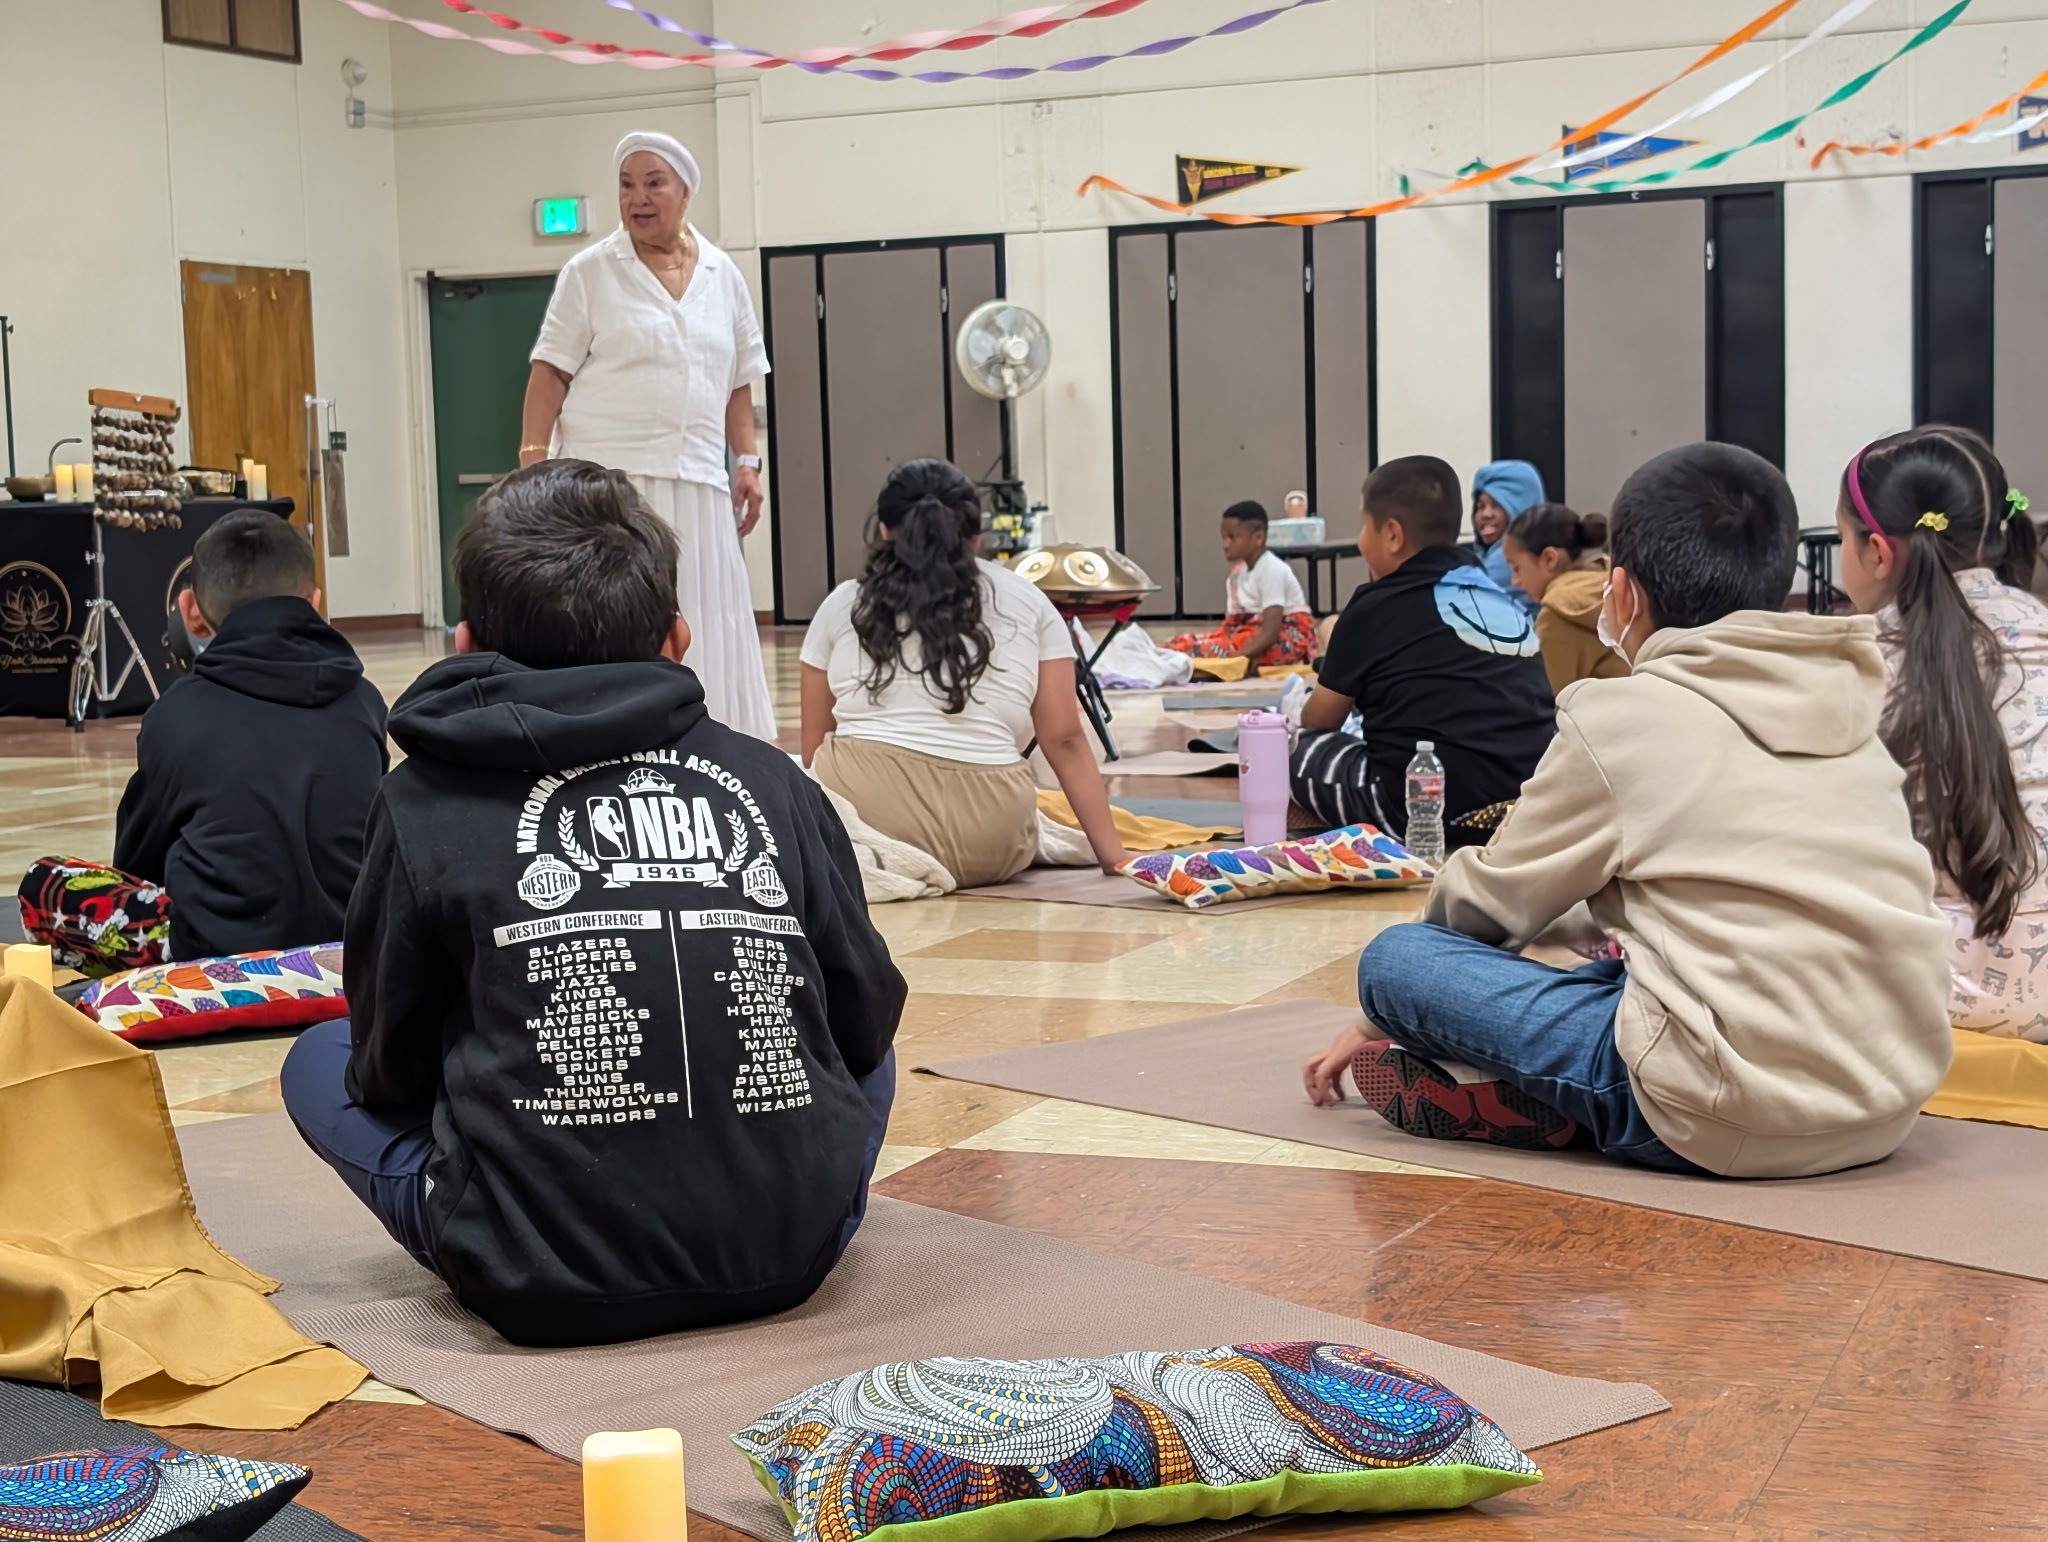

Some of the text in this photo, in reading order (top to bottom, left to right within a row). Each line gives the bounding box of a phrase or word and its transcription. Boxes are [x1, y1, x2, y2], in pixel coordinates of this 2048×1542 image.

[516, 774, 565, 854] NATIONAL
[684, 755, 778, 857] ASSCOCIATION
[629, 796, 724, 860] NBA
[636, 866, 696, 879] 1946
[521, 871, 577, 895] WESTERN
[506, 913, 645, 941] WESTERN CONFERENCE
[699, 912, 803, 933] EASTERN CONFEREN
[529, 937, 627, 958] BLAZERS
[732, 936, 785, 951] 76ERS
[528, 949, 632, 970] CLIPPERS
[733, 947, 788, 962] BUCKS
[527, 961, 637, 983] GRIZZLIES
[737, 958, 787, 973] BULLS
[556, 974, 609, 990] JAZZ
[714, 969, 805, 987] CAVALIERS
[551, 986, 616, 1003] KINGS
[544, 997, 627, 1016] LAKERS
[727, 1004, 792, 1017] HORNS
[526, 1008, 650, 1030] MAVERICKS
[538, 1021, 639, 1040] NUGGETS
[738, 1026, 798, 1040] KNICKS
[536, 1033, 643, 1052] PELICANS
[745, 1037, 797, 1051] MAGIC
[540, 1046, 641, 1063] ROCKETS
[752, 1048, 793, 1062] NETS
[556, 1059, 629, 1075] SPURS
[739, 1058, 803, 1075] PACERS
[563, 1072, 623, 1086] SUNS
[735, 1069, 807, 1087] PISTONS
[544, 1082, 646, 1099] THUNDER
[732, 1080, 810, 1099] RAPTORS
[512, 1092, 679, 1111] TIMBERWOLVES
[736, 1094, 813, 1114] WIZARDS
[541, 1108, 657, 1126] WARRIORS
